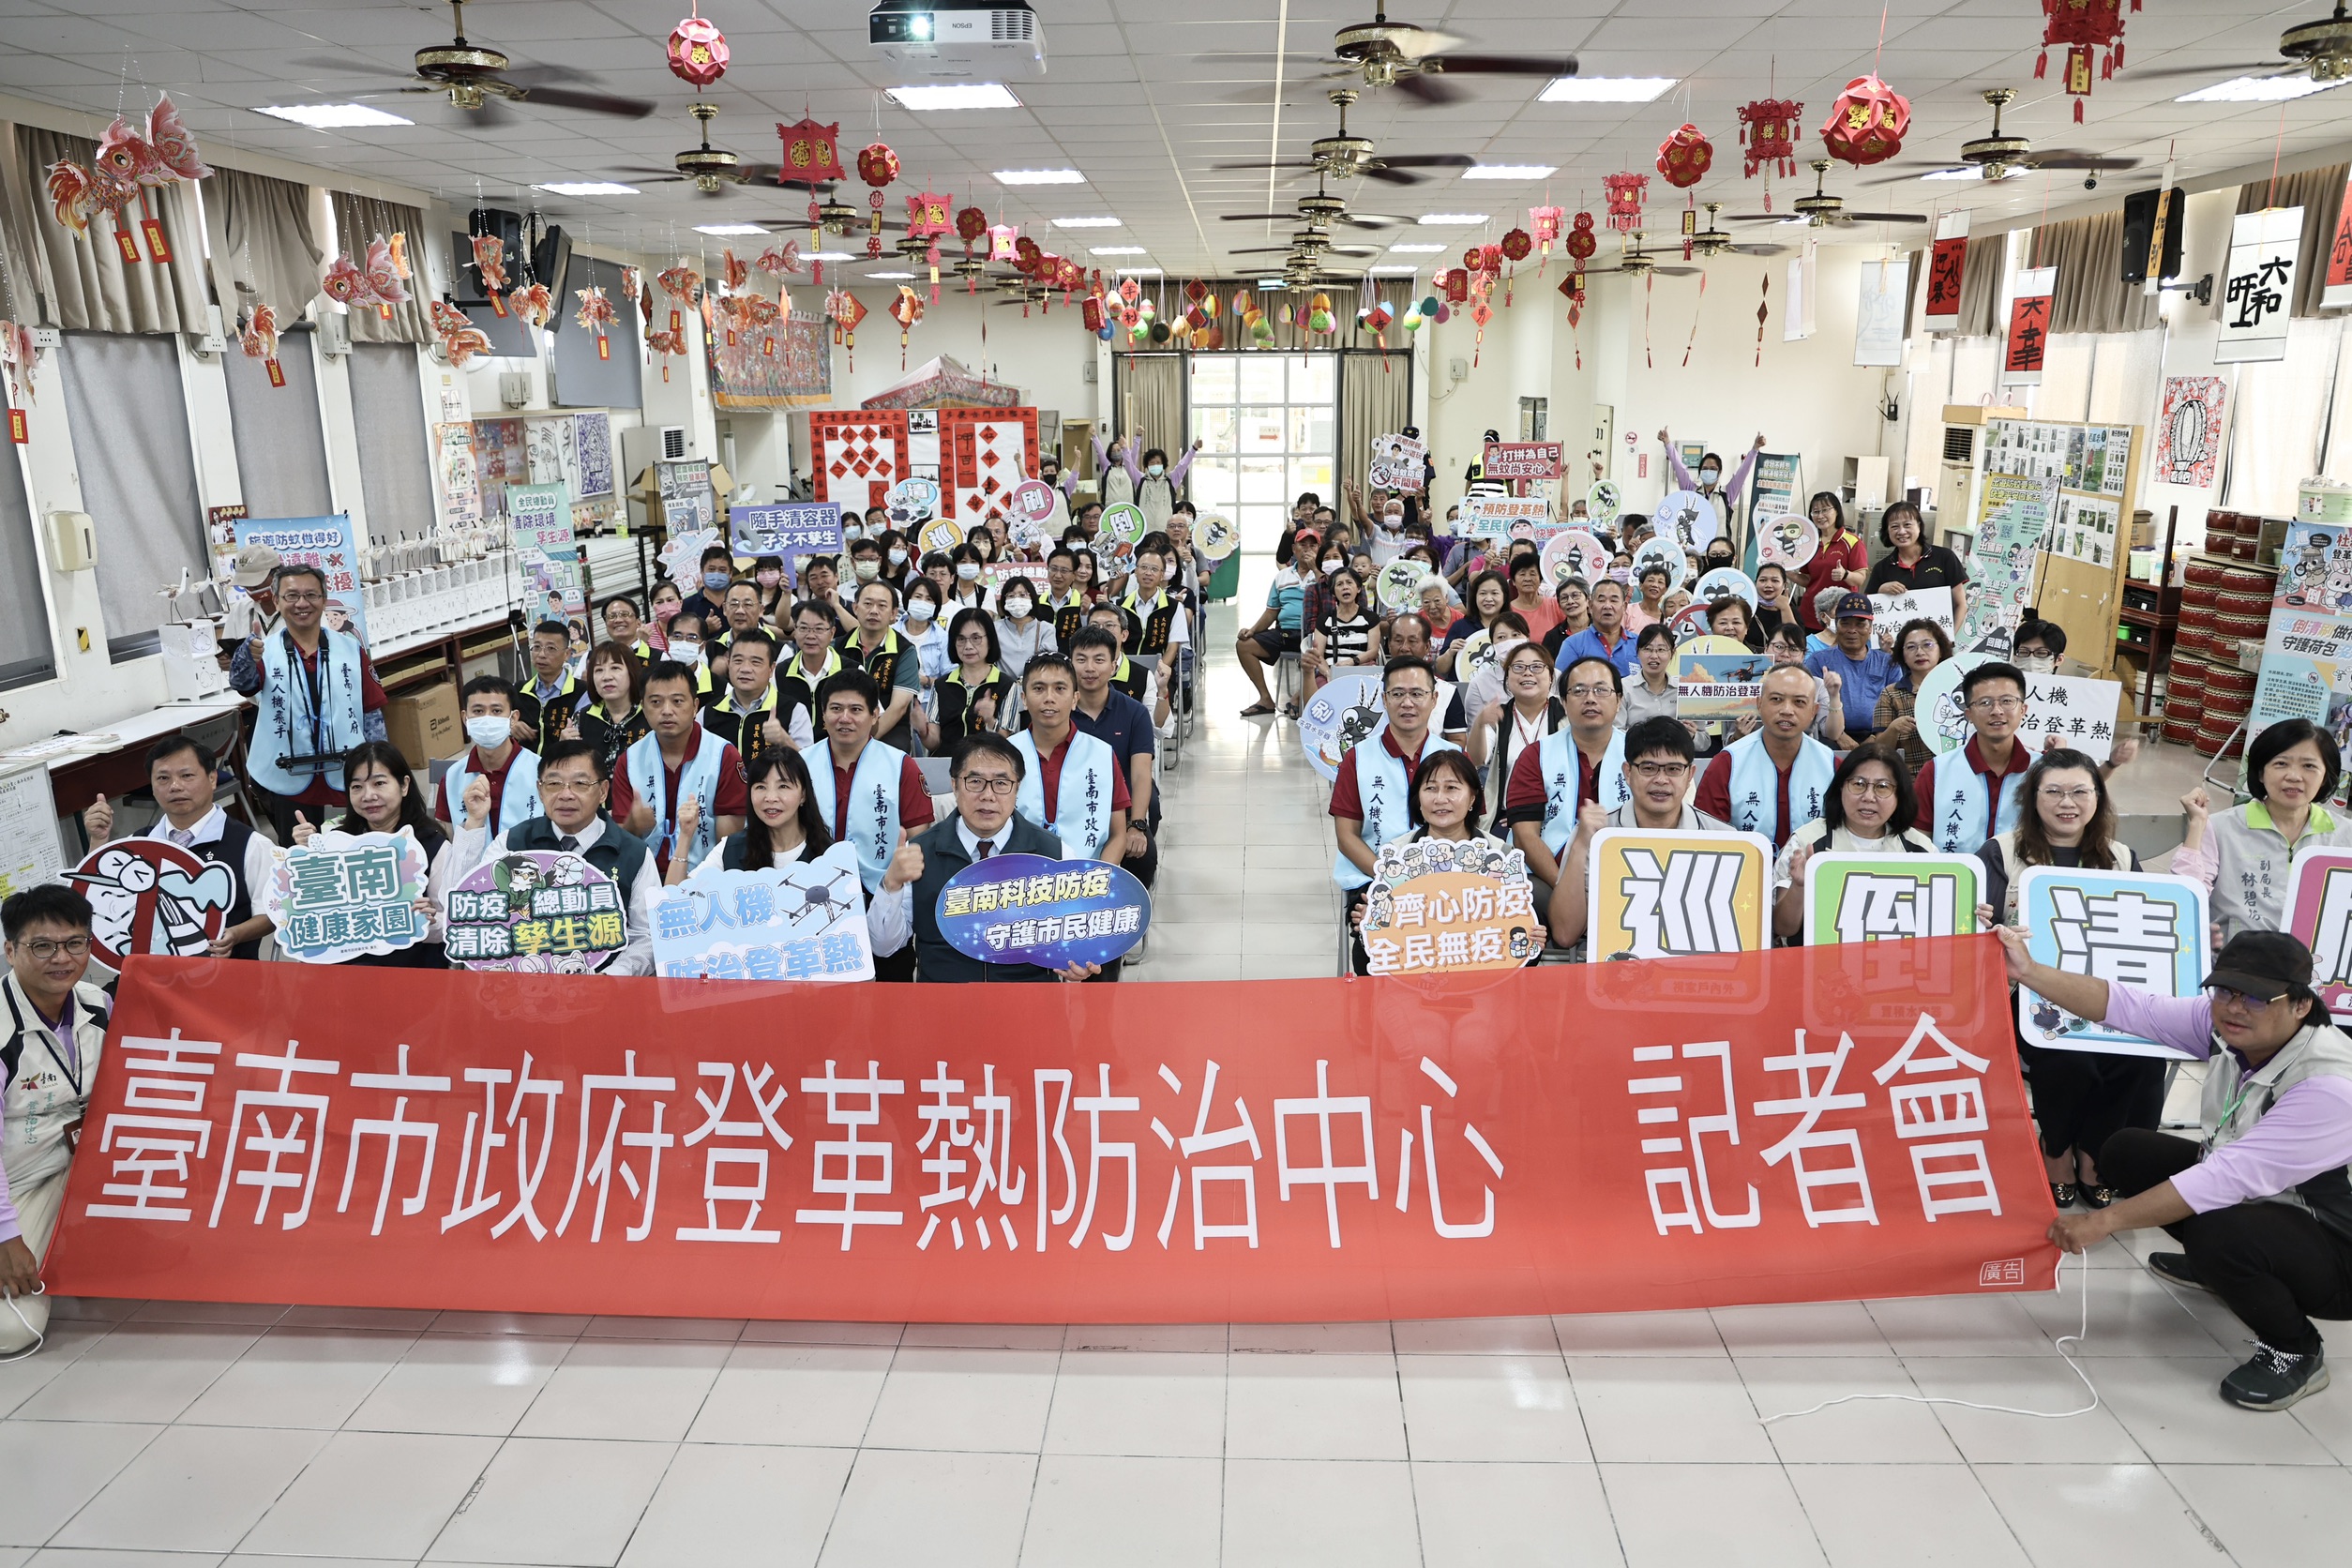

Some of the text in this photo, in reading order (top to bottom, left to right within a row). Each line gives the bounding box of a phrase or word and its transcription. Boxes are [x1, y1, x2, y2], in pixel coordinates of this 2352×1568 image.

[1486, 462, 1545, 475] 無蚊尚安心
[1502, 447, 1559, 461] 打拼為自己
[518, 497, 555, 507] 全民總動員
[749, 509, 837, 529] 隨手清容器
[1020, 490, 1045, 513] 刷
[1483, 504, 1546, 517] 預防登革熱
[248, 531, 339, 547] 旅遊防蚊做得好
[512, 513, 556, 530] 清除環境
[927, 525, 955, 549] 巡
[1109, 511, 1135, 534] 倒
[2337, 534, 2352, 548] 杜
[1872, 598, 1919, 614] 無人機
[1872, 615, 1952, 635] 防治熱
[271, 668, 286, 739] 無人機飛手
[1311, 699, 1334, 723] 刷
[1678, 686, 1761, 700] 無人機防治登革
[873, 784, 887, 861] 臺南市政府
[1082, 767, 1100, 848] 臺南市政府
[285, 845, 400, 910] 臺南
[943, 867, 1111, 918] 臺南科技防疫
[2259, 859, 2272, 898] 副局長
[450, 881, 616, 921] 防疫 總動員
[657, 883, 776, 941] 無人機
[1394, 882, 1532, 929] 齊心防疫
[1620, 847, 1746, 971] 巡
[288, 901, 415, 949] 健康家園
[986, 906, 1140, 950] 守護市民健康
[1835, 871, 1958, 997] 倒
[2049, 886, 2179, 997] 清
[665, 932, 864, 998] 防治登革熱
[1369, 927, 1505, 975] 全民無疫
[85, 1011, 2002, 1252] 臺南市政府登革熱防治中心 記者會
[1983, 1260, 2020, 1284] 廣告
